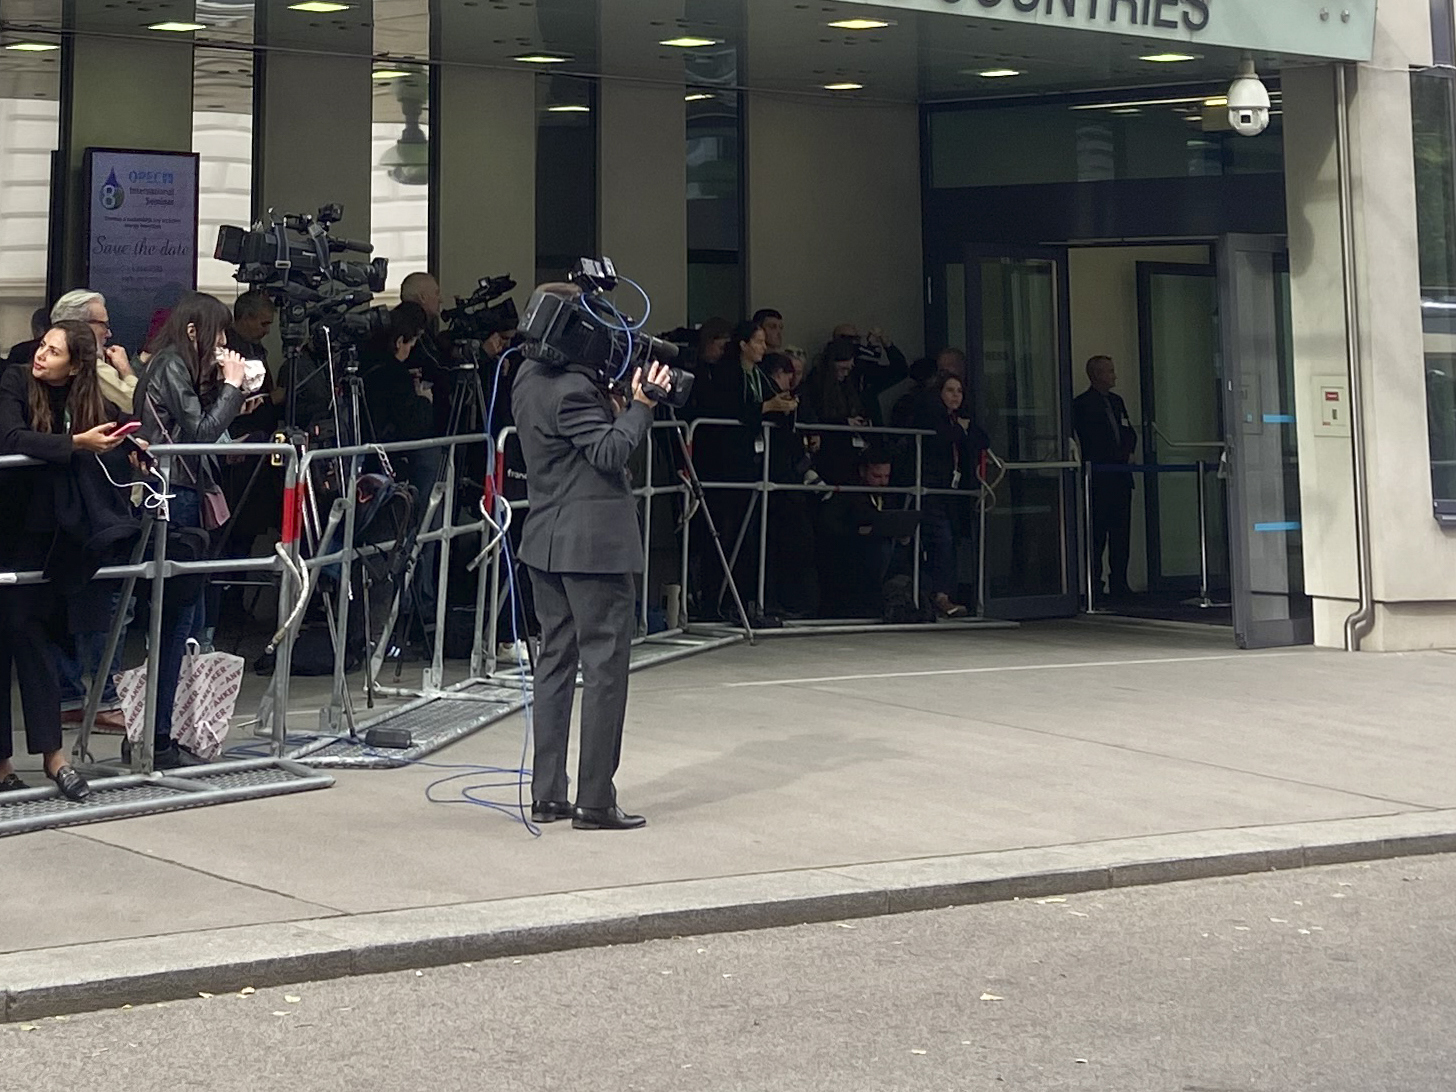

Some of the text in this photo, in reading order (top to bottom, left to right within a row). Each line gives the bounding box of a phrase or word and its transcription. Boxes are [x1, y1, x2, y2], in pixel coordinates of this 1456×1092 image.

[94, 235, 188, 256] Save the date
